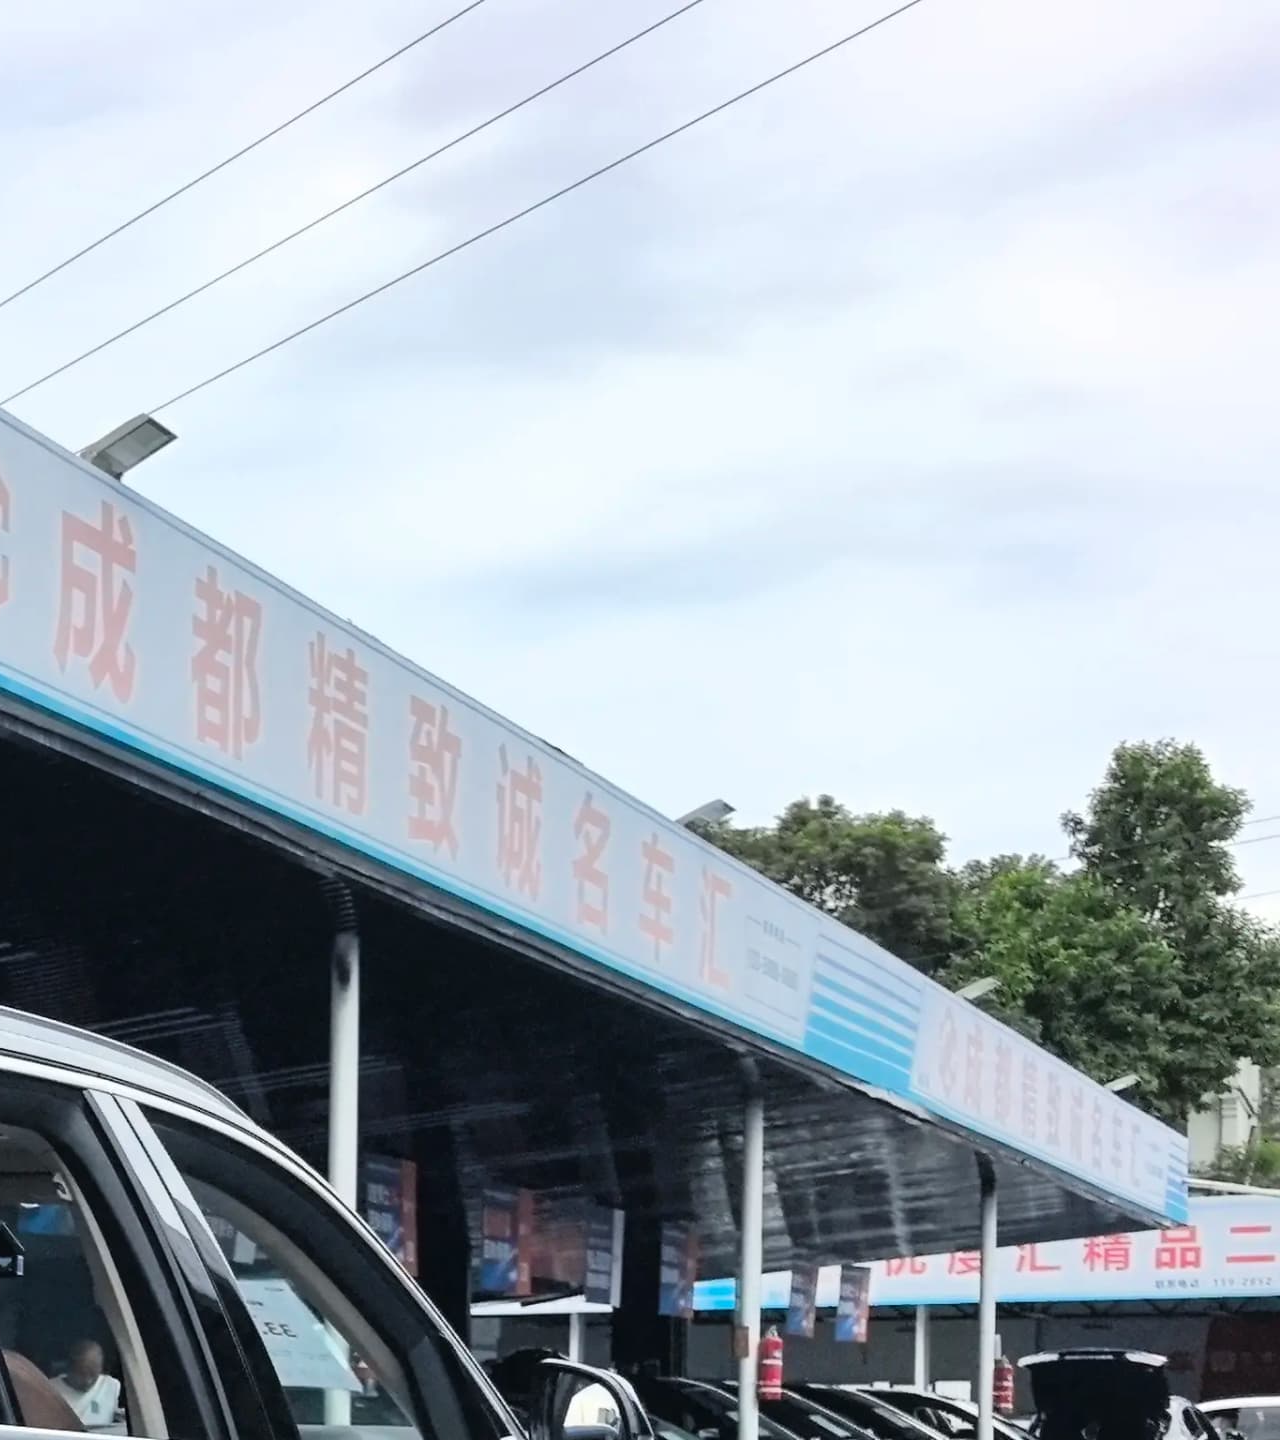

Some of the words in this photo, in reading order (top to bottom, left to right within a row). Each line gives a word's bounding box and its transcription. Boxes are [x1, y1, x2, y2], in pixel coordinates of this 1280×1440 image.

[52, 498, 733, 989] 成都精致诚名车汇
